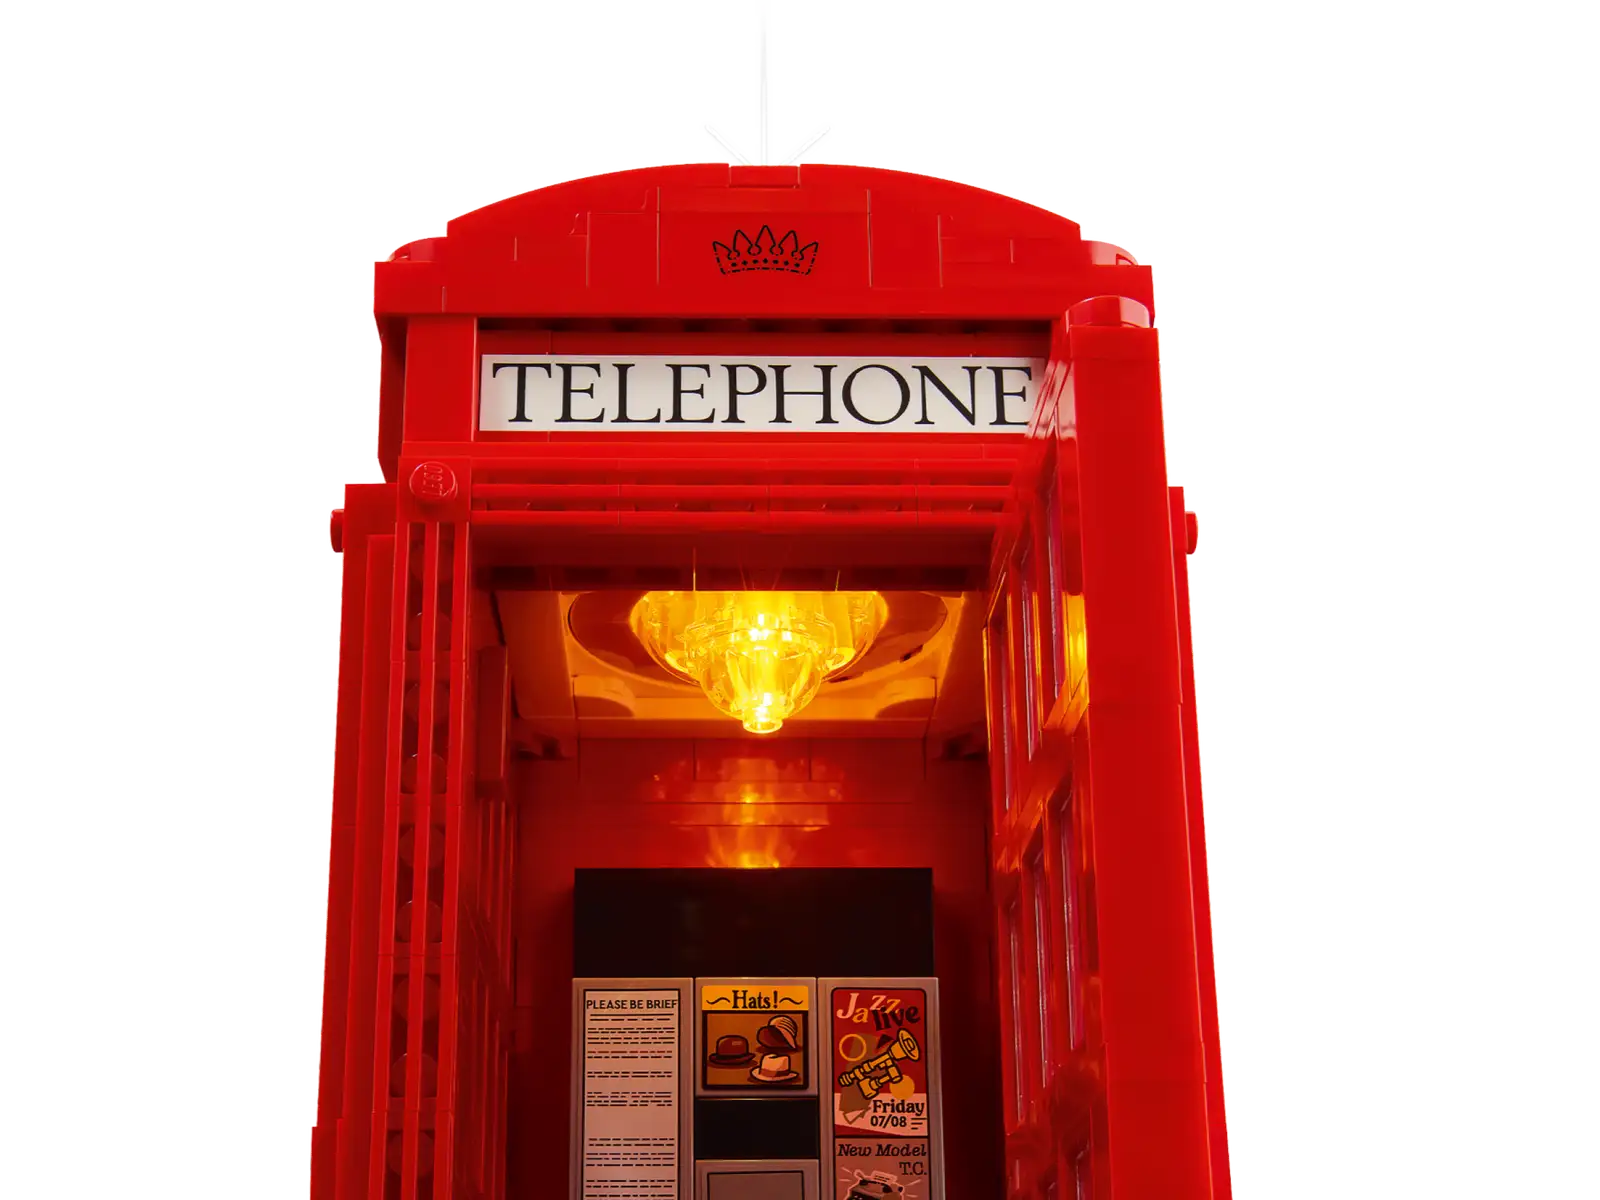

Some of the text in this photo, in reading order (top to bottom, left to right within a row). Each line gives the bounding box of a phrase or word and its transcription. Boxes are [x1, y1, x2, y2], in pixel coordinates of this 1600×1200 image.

[492, 362, 1034, 426] TELEPHONE
[586, 999, 678, 1010] PLEASE BE BRIEF
[731, 989, 778, 1009] Hats!
[836, 992, 901, 1024] Jazz
[871, 1005, 921, 1032] live
[872, 1099, 925, 1117] Friday
[870, 1114, 907, 1129] 07/08
[836, 1143, 927, 1157] New Model
[898, 1161, 928, 1176] T.C.
